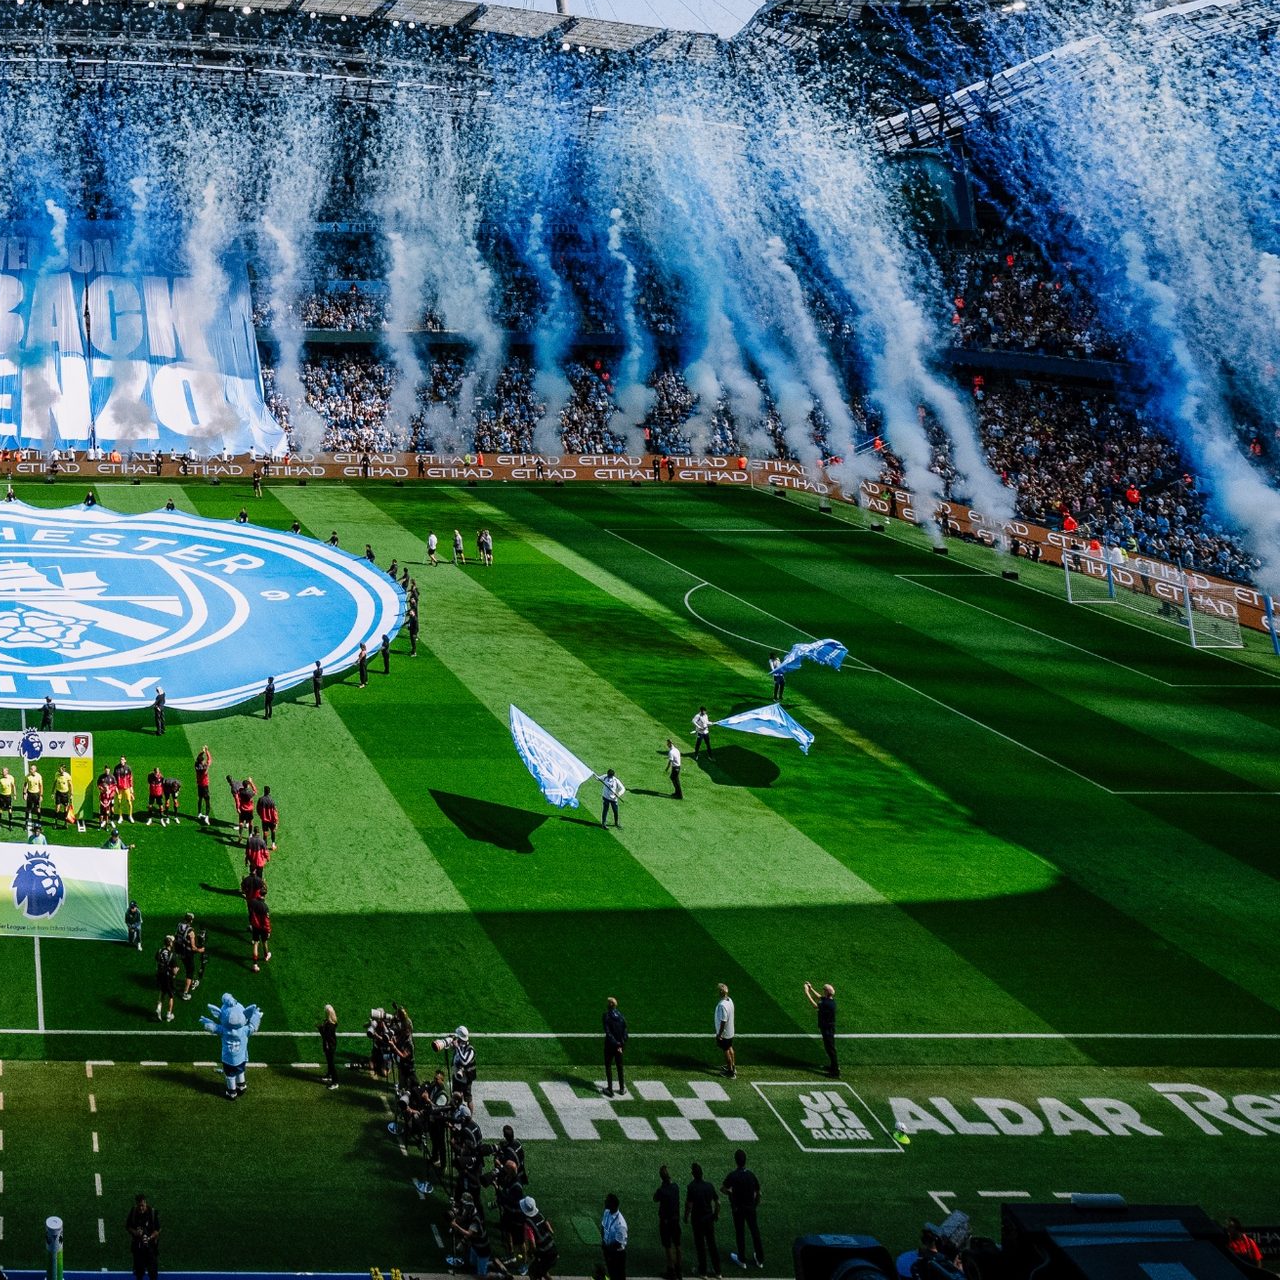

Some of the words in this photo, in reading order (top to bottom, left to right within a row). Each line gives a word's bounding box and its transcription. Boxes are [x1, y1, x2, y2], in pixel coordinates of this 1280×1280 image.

[179, 464, 244, 475] ETIHAD
[261, 465, 326, 477] ETIHAD
[343, 466, 409, 477] ETIHAD
[427, 467, 493, 479] ETIHAD
[511, 468, 577, 480] ETHAD
[678, 470, 748, 481] ETIHAD
[497, 455, 560, 466] ETIHAD
[579, 456, 642, 466] ETIHAD
[670, 457, 728, 468] TIHAD
[768, 474, 829, 494] ETIHAD
[1155, 581, 1237, 617] ETHAD
[1135, 557, 1210, 590] ETIHD
[259, 584, 327, 603] 94
[7, 923, 26, 931] League
[470, 1080, 760, 1141] OKX
[889, 1096, 1165, 1136] ALDAR
[1147, 1082, 1280, 1136] Re
[811, 1128, 874, 1140] ALDAR
